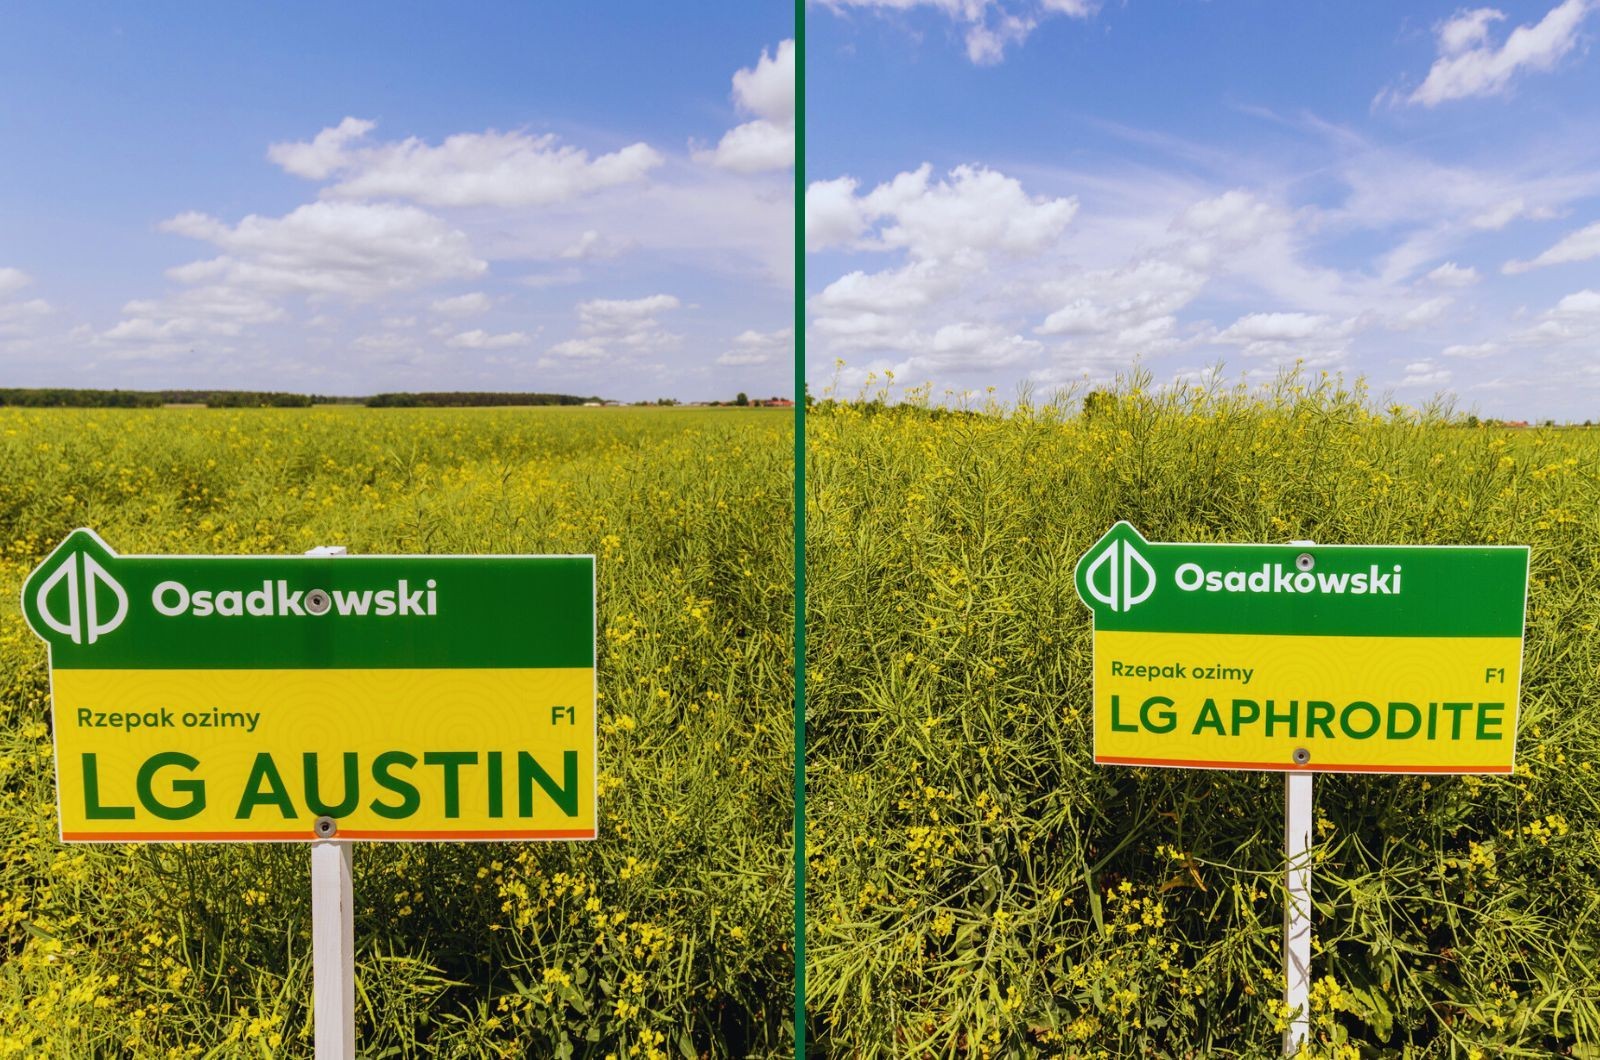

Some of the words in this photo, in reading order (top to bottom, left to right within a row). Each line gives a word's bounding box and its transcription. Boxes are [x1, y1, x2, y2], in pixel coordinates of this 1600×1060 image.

[1175, 563, 1402, 595] Osadkowski
[1111, 661, 1186, 682] Rzepak
[1192, 664, 1254, 685] ozimy
[1485, 668, 1505, 684] F1
[77, 706, 175, 731] Rzepak
[182, 708, 261, 731] ozimy
[550, 706, 576, 726] F1
[1111, 695, 1177, 733] LG
[1192, 698, 1505, 741] APHRODITE
[82, 751, 207, 821] LG
[235, 750, 579, 820] AUSTIN
